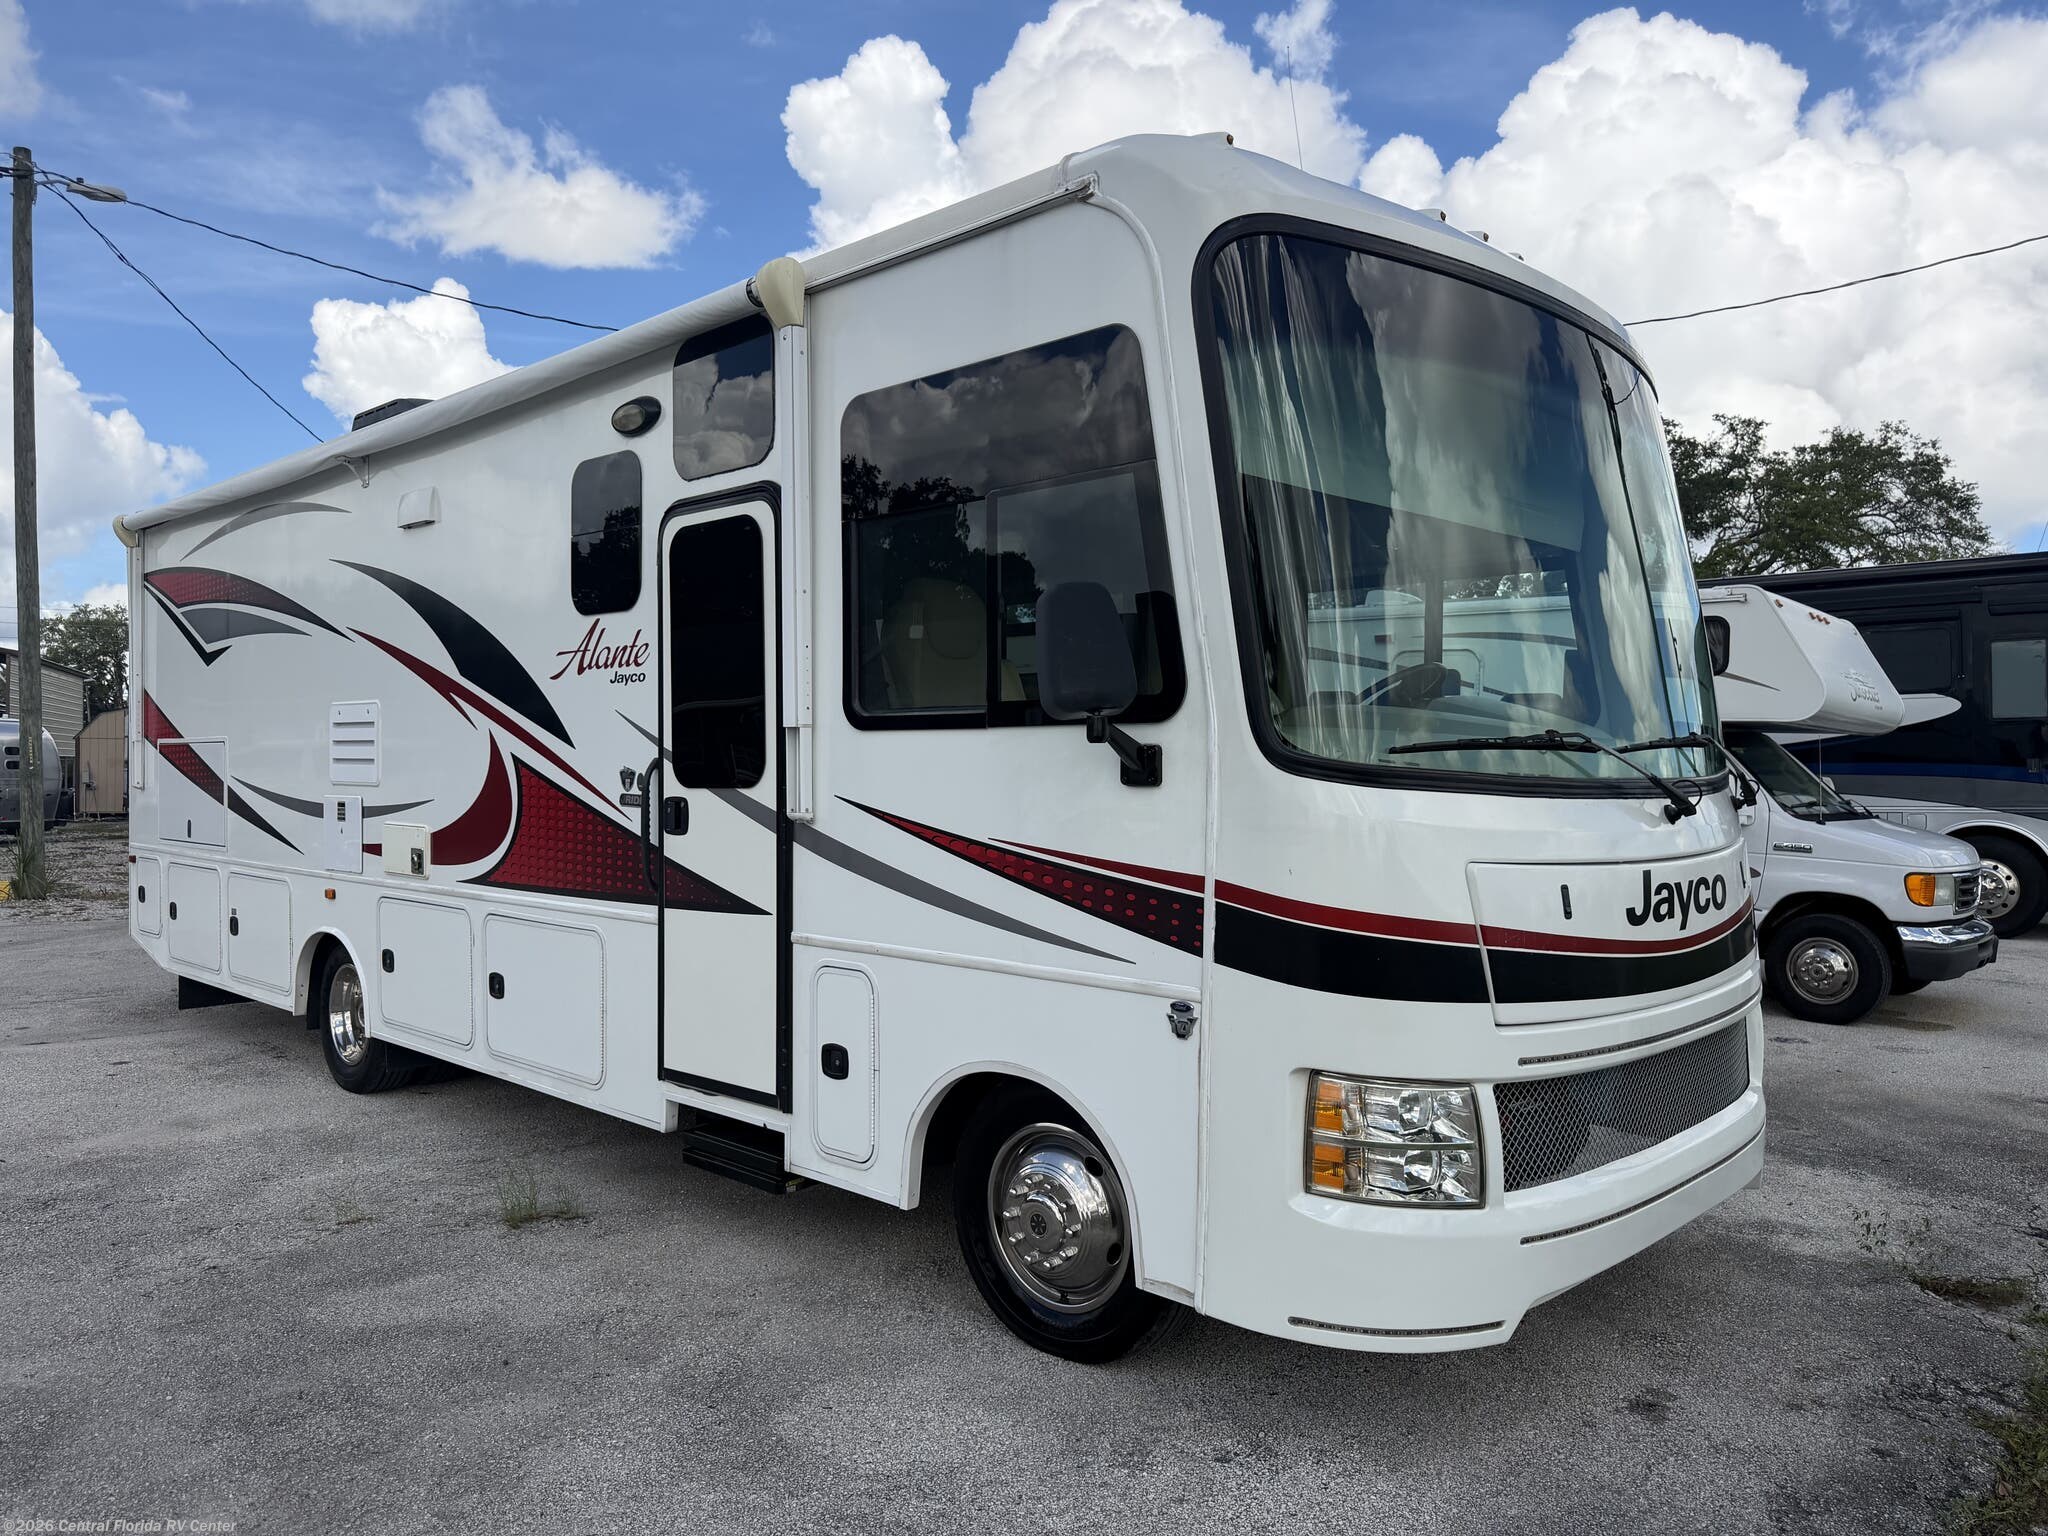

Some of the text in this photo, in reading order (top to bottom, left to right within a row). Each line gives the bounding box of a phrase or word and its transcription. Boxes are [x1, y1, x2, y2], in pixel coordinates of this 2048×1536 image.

[549, 618, 650, 680] Alante
[610, 671, 646, 686] Jayco
[1626, 869, 1726, 931] Jayco
